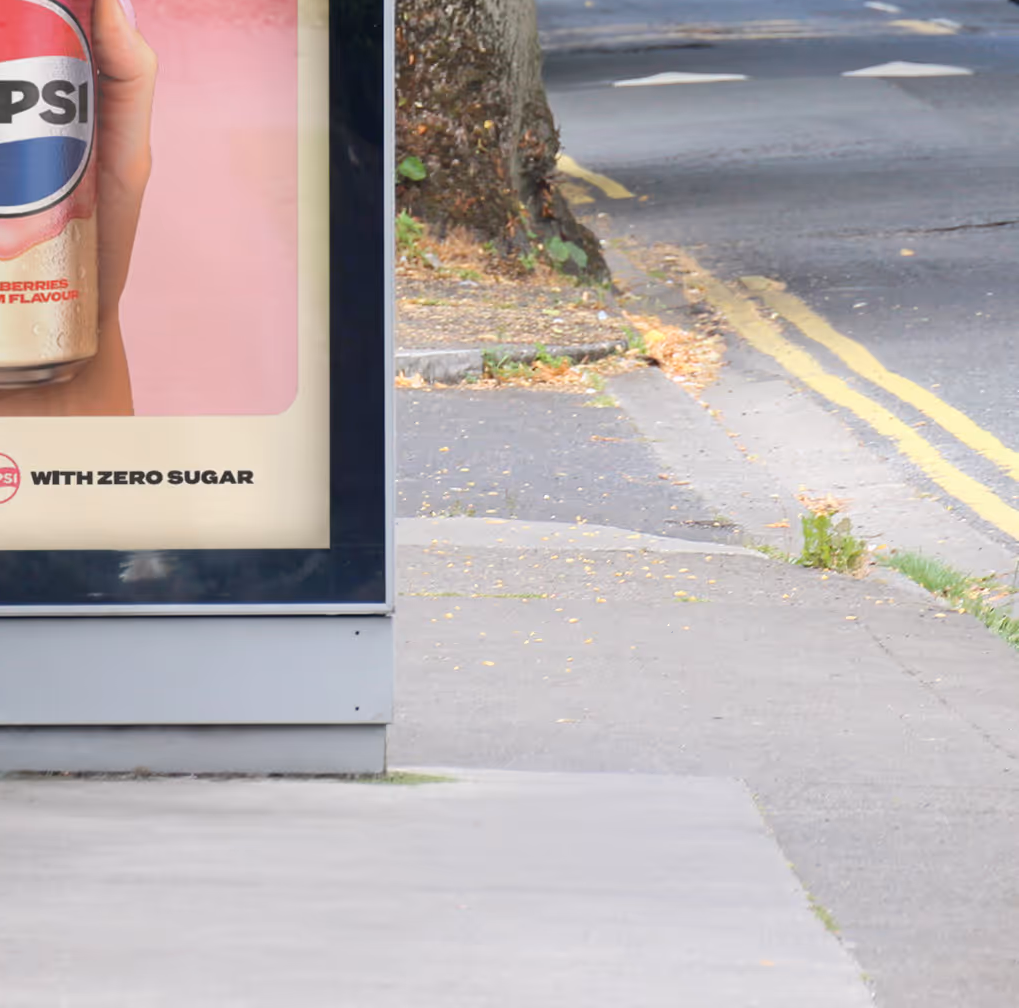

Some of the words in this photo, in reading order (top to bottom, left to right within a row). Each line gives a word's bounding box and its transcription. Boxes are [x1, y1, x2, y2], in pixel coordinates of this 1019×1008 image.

[8, 289, 80, 304] FLAVOUR
[31, 470, 96, 485] WITH
[97, 470, 164, 485] ZERO
[167, 469, 254, 485] SUGAR
